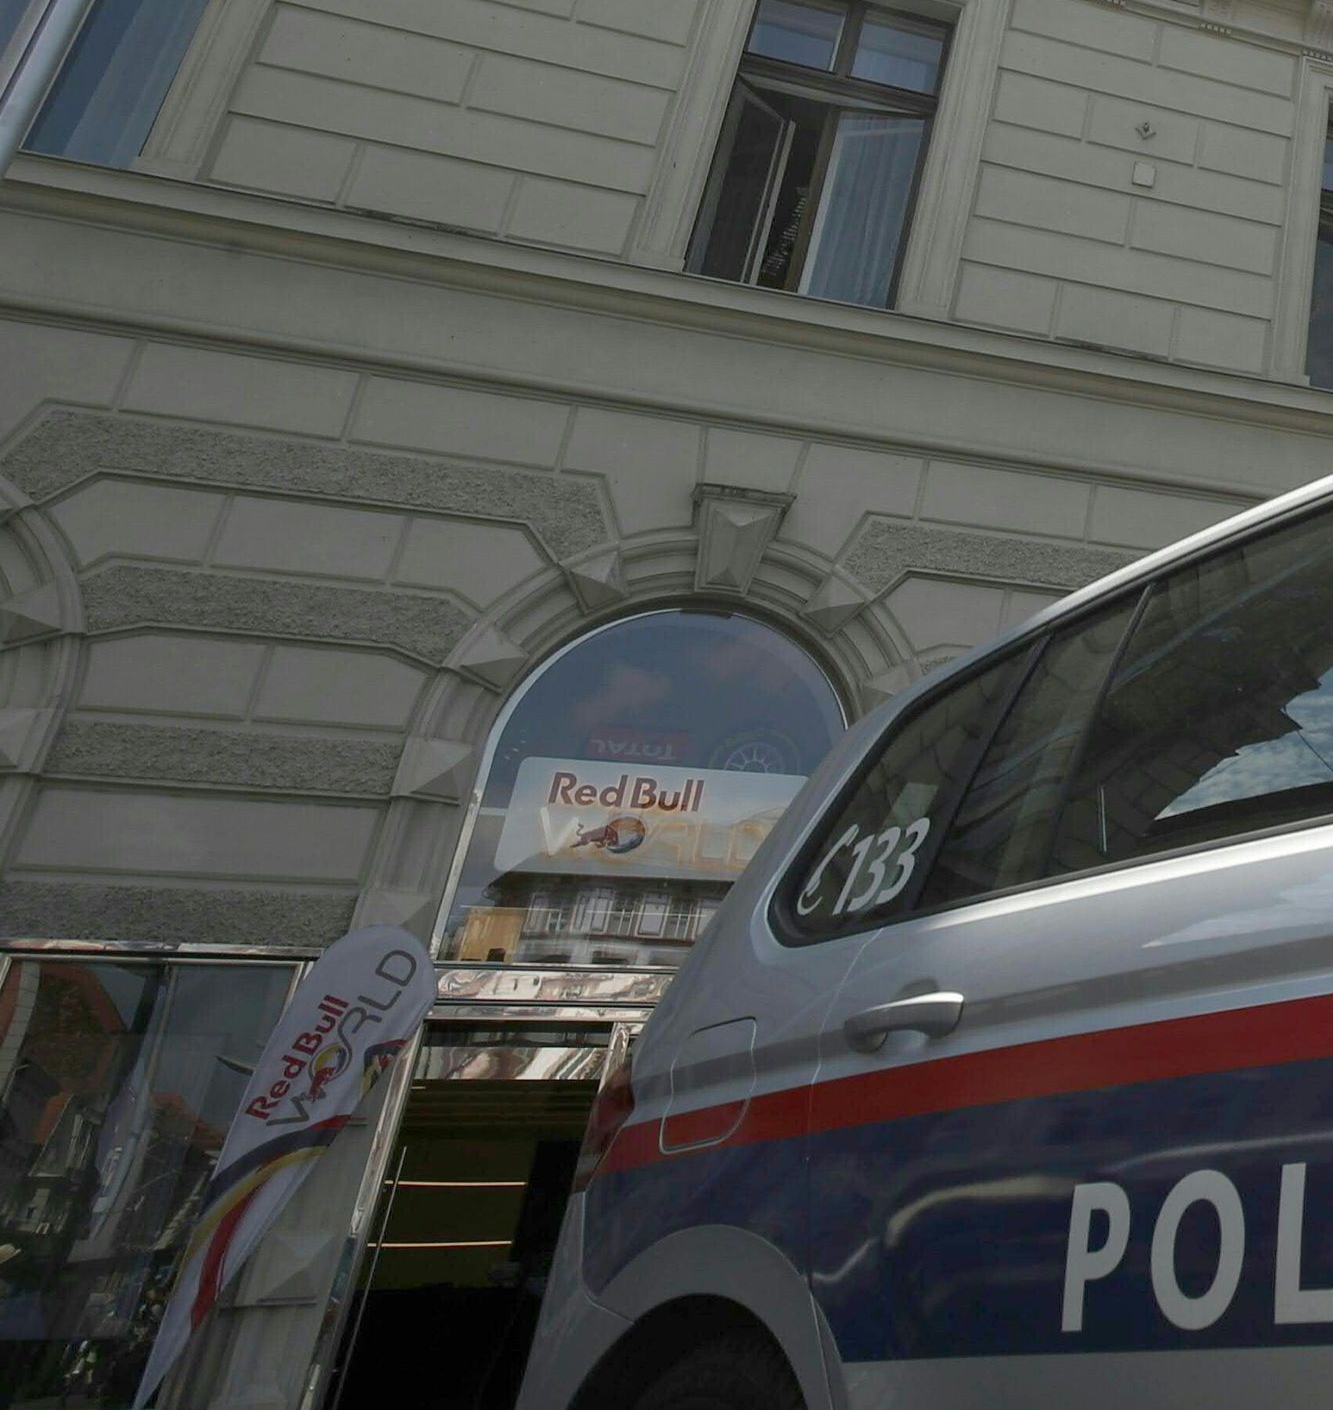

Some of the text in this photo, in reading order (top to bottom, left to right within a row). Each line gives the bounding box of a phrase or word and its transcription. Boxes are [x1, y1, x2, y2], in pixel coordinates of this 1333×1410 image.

[589, 738, 677, 761] TOTAL
[548, 772, 705, 812] Red Bull
[831, 817, 931, 916] 133
[244, 994, 350, 1120] Red Bull
